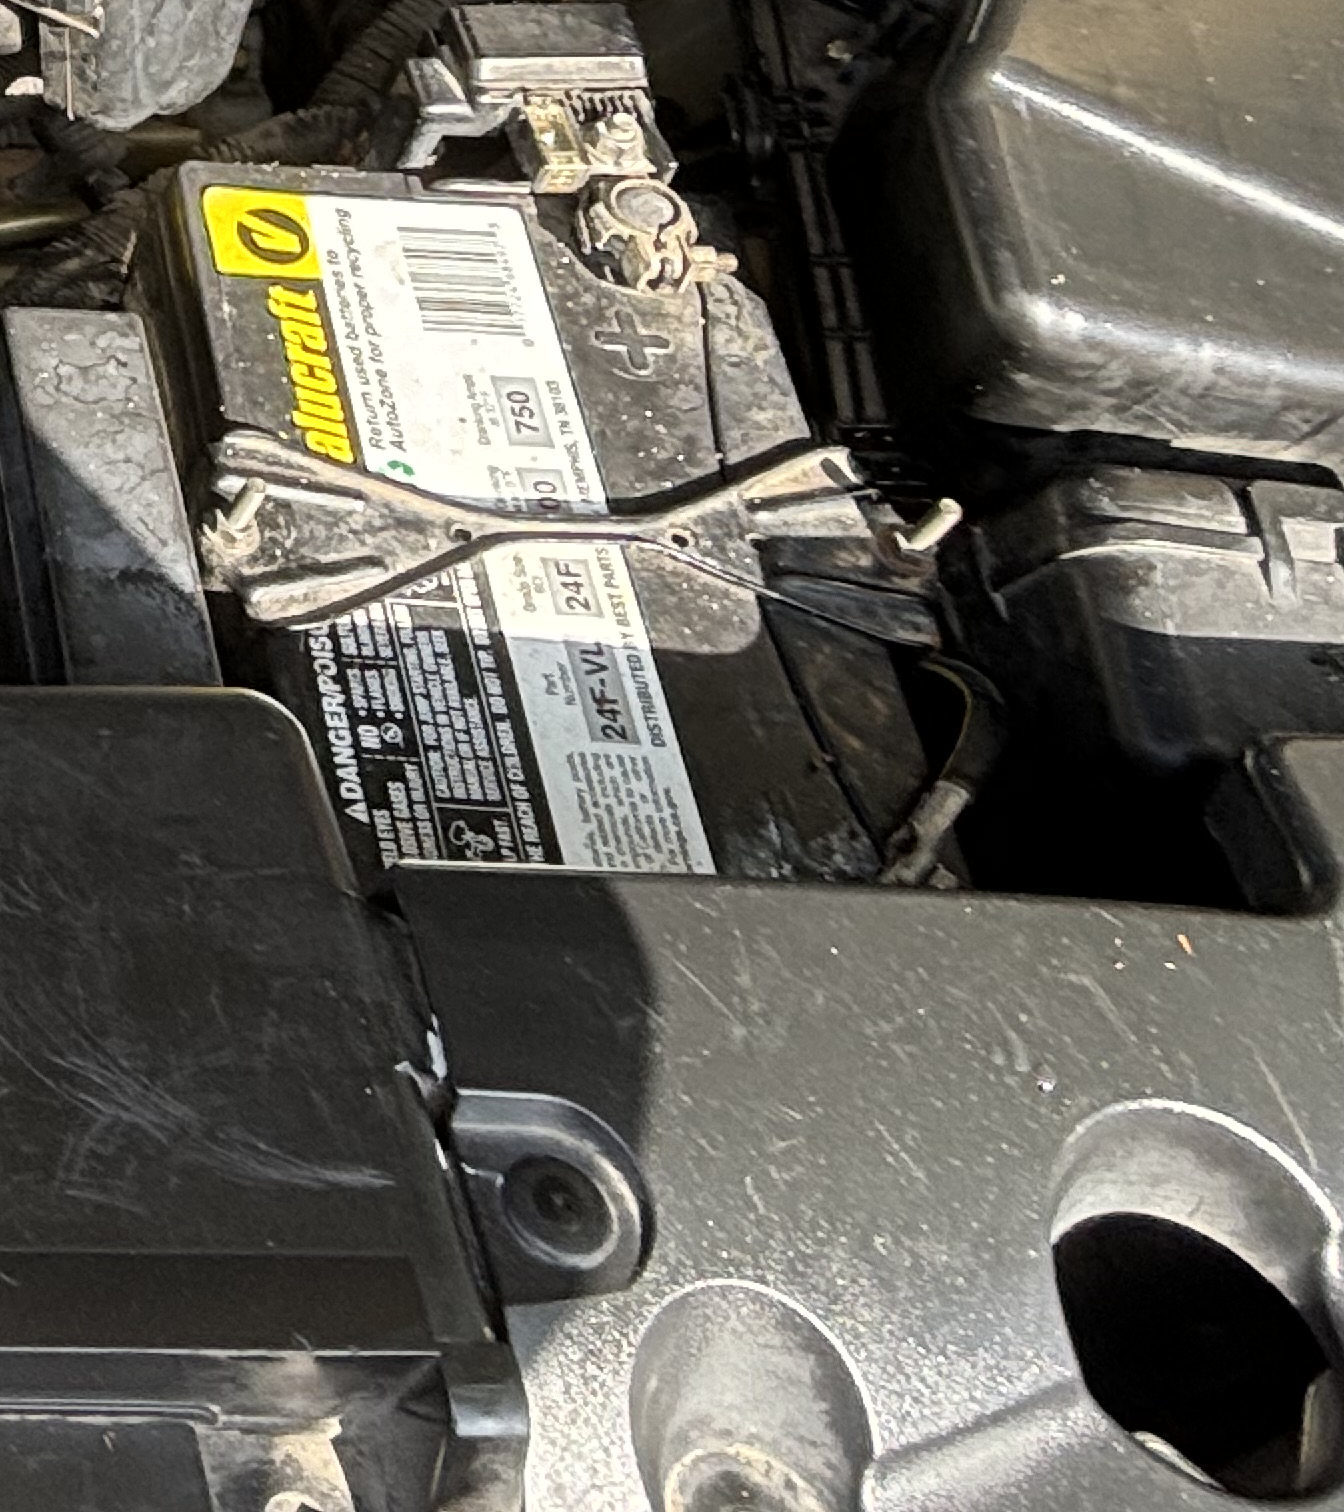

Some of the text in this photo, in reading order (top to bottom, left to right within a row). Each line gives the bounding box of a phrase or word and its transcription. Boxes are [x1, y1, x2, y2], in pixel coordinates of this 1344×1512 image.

[326, 249, 386, 450] Return used batteries to
[335, 208, 407, 453] AutoZone for proper recycling
[266, 284, 356, 464] alucraft
[506, 390, 539, 434] 750
[558, 420, 573, 435] TN
[532, 481, 560, 509] 00
[554, 560, 591, 611] 24F
[594, 547, 620, 589] PARTS
[607, 593, 631, 627] BEST
[541, 673, 559, 695] Part
[557, 661, 576, 706] Number
[579, 642, 628, 740] 24F-VL
[626, 654, 667, 747] DISTRIBUTED
[357, 725, 382, 749] NO
[511, 783, 530, 799] OF
[372, 809, 395, 838] EYES
[515, 800, 542, 842] REACH
